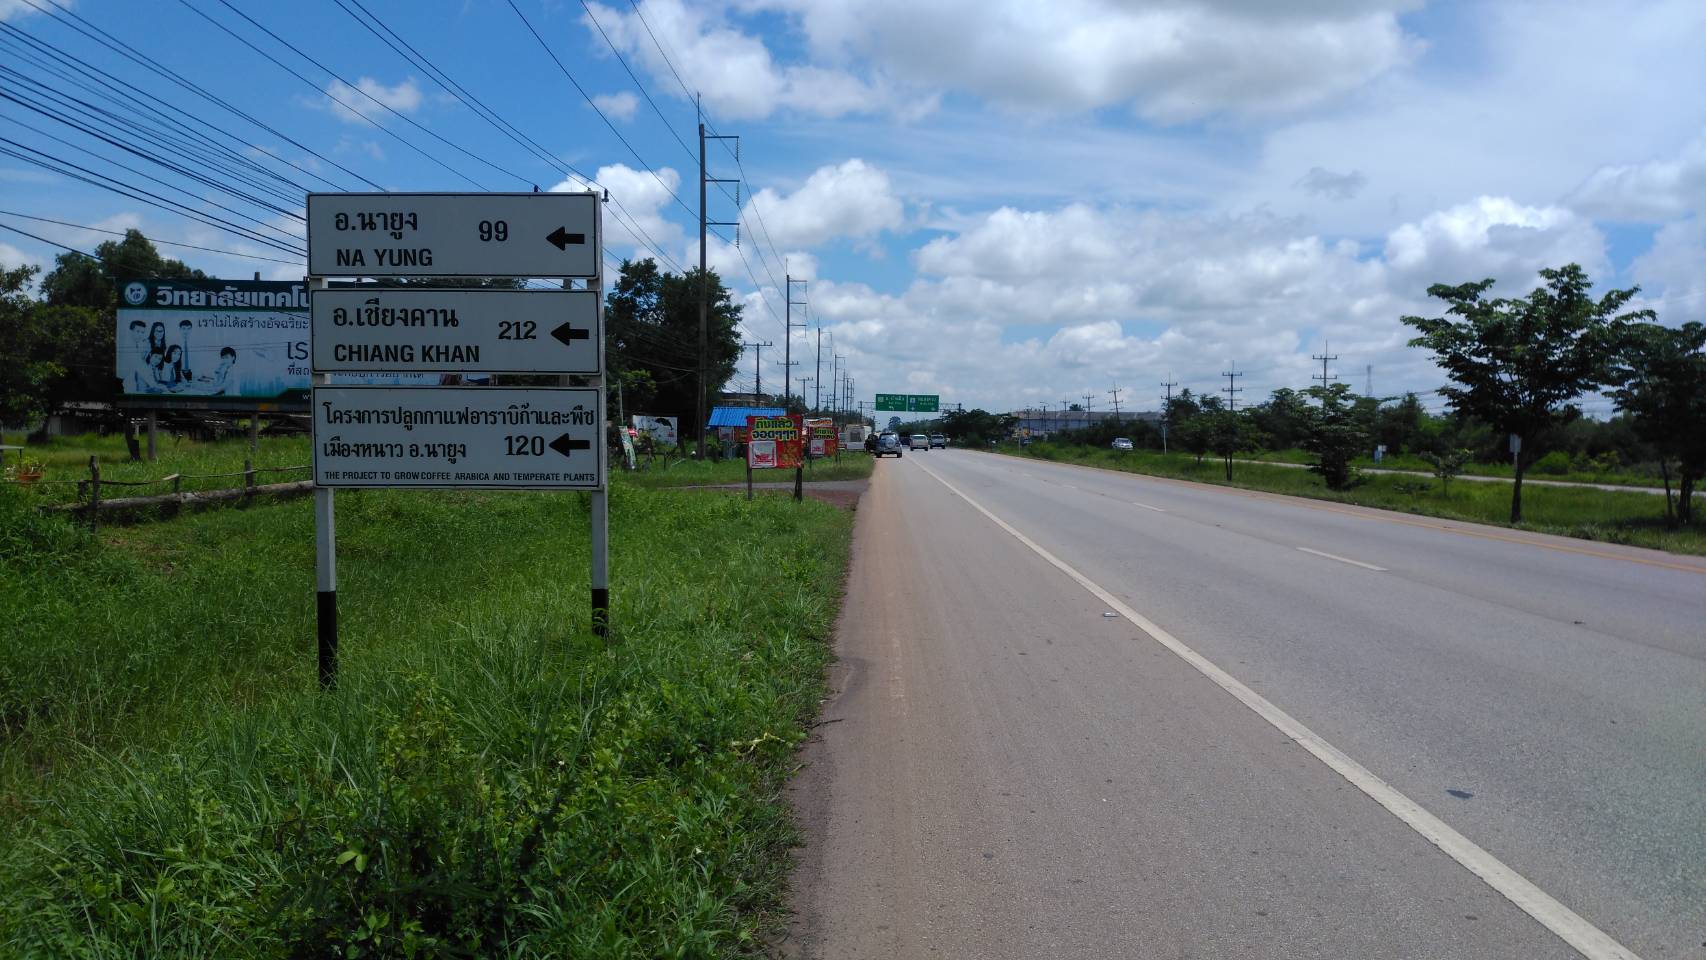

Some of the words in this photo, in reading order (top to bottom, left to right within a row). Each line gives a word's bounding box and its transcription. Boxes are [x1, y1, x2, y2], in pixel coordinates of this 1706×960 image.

[335, 212, 418, 240] อ.นายูง
[478, 220, 509, 242] 99
[336, 249, 366, 267] NA
[374, 249, 433, 267] YUNG
[333, 298, 459, 328] อ.เชียงคาน
[498, 320, 537, 341] 212
[334, 344, 414, 363] CHIANG
[421, 344, 480, 363] KHAN
[323, 435, 404, 458] เมืองหนาว
[409, 443, 466, 464] อ.นายูง
[504, 435, 545, 456] 120
[325, 471, 340, 480] THE
[342, 471, 378, 480] PROJECT
[380, 471, 391, 480] TO
[454, 472, 490, 481] ARABICA
[493, 472, 510, 481] AND
[513, 472, 560, 481] TEMPERATE
[563, 473, 595, 482] PLANTS
